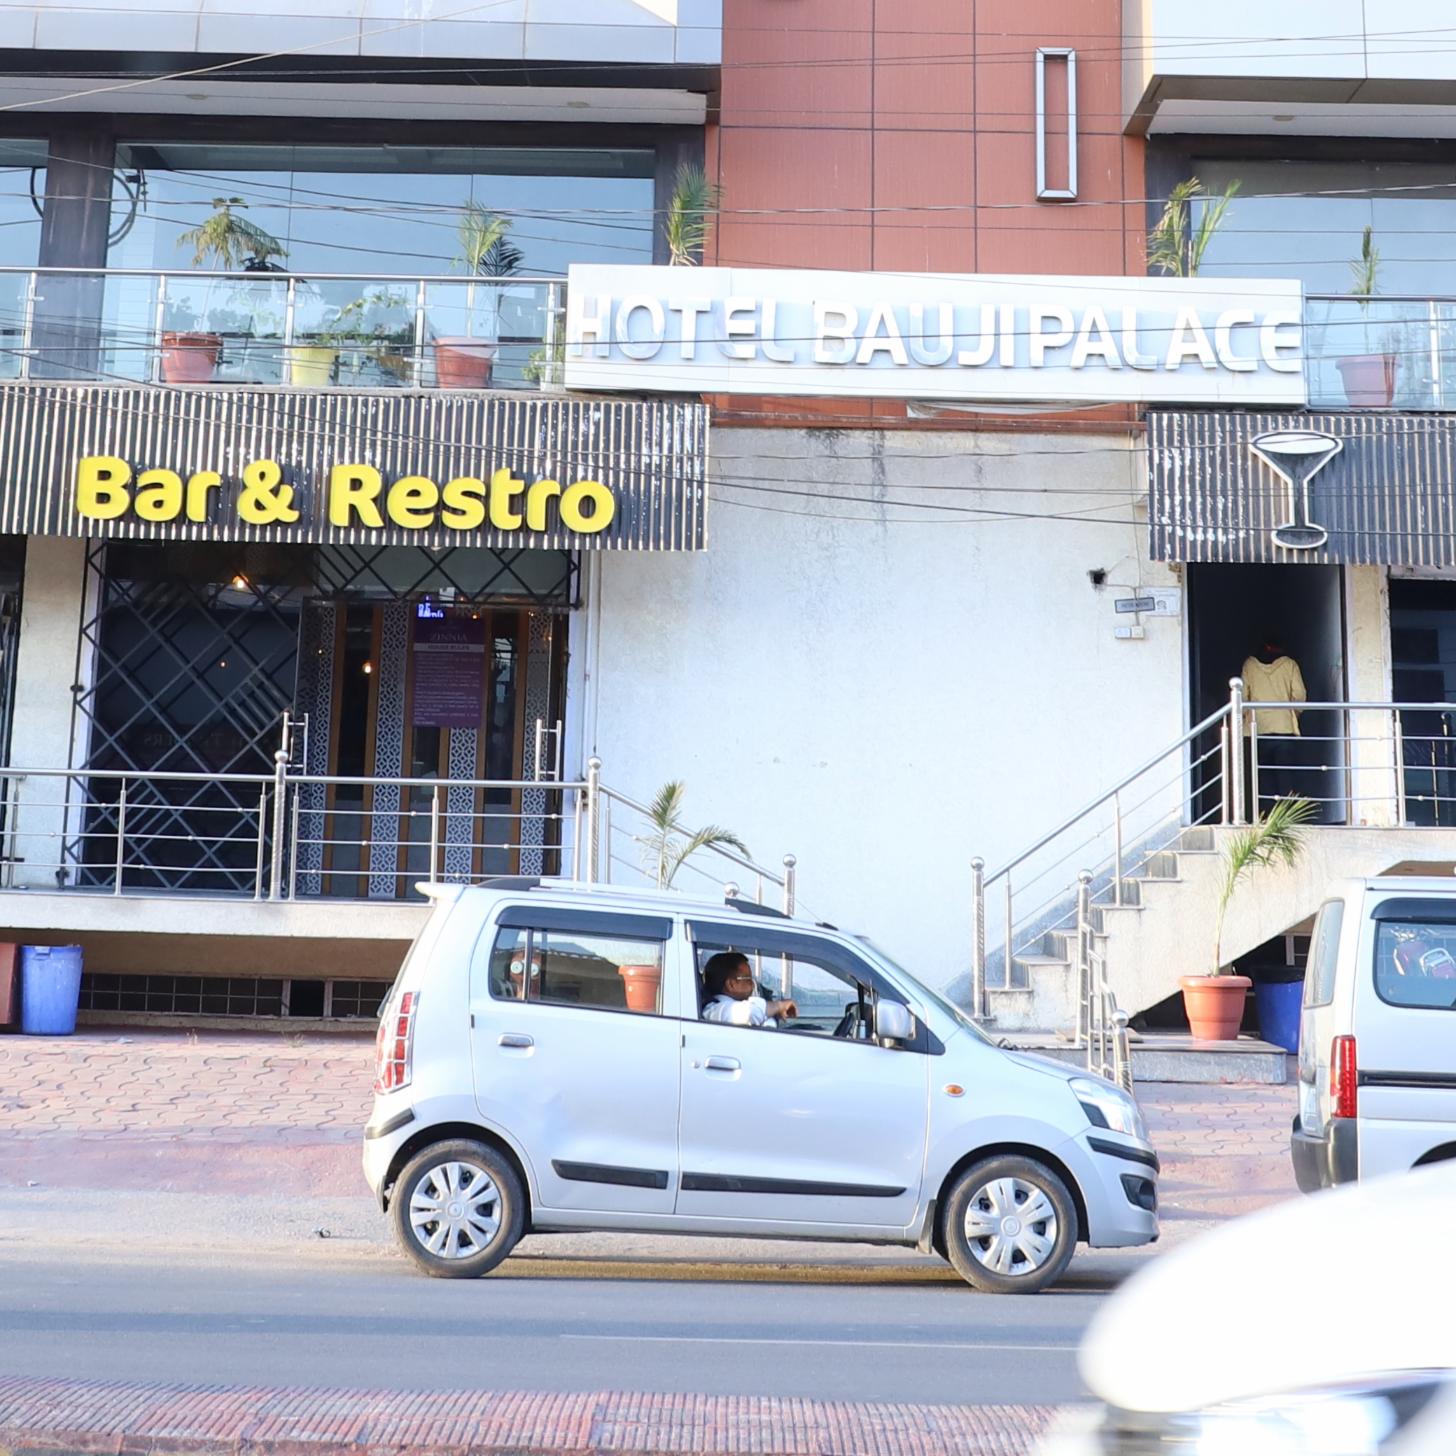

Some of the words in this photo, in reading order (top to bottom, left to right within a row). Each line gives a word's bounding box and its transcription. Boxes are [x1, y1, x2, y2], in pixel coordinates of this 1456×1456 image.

[568, 294, 795, 362] HOTEL
[76, 455, 222, 524] Bar
[236, 459, 301, 525] &
[328, 463, 616, 535] Restro
